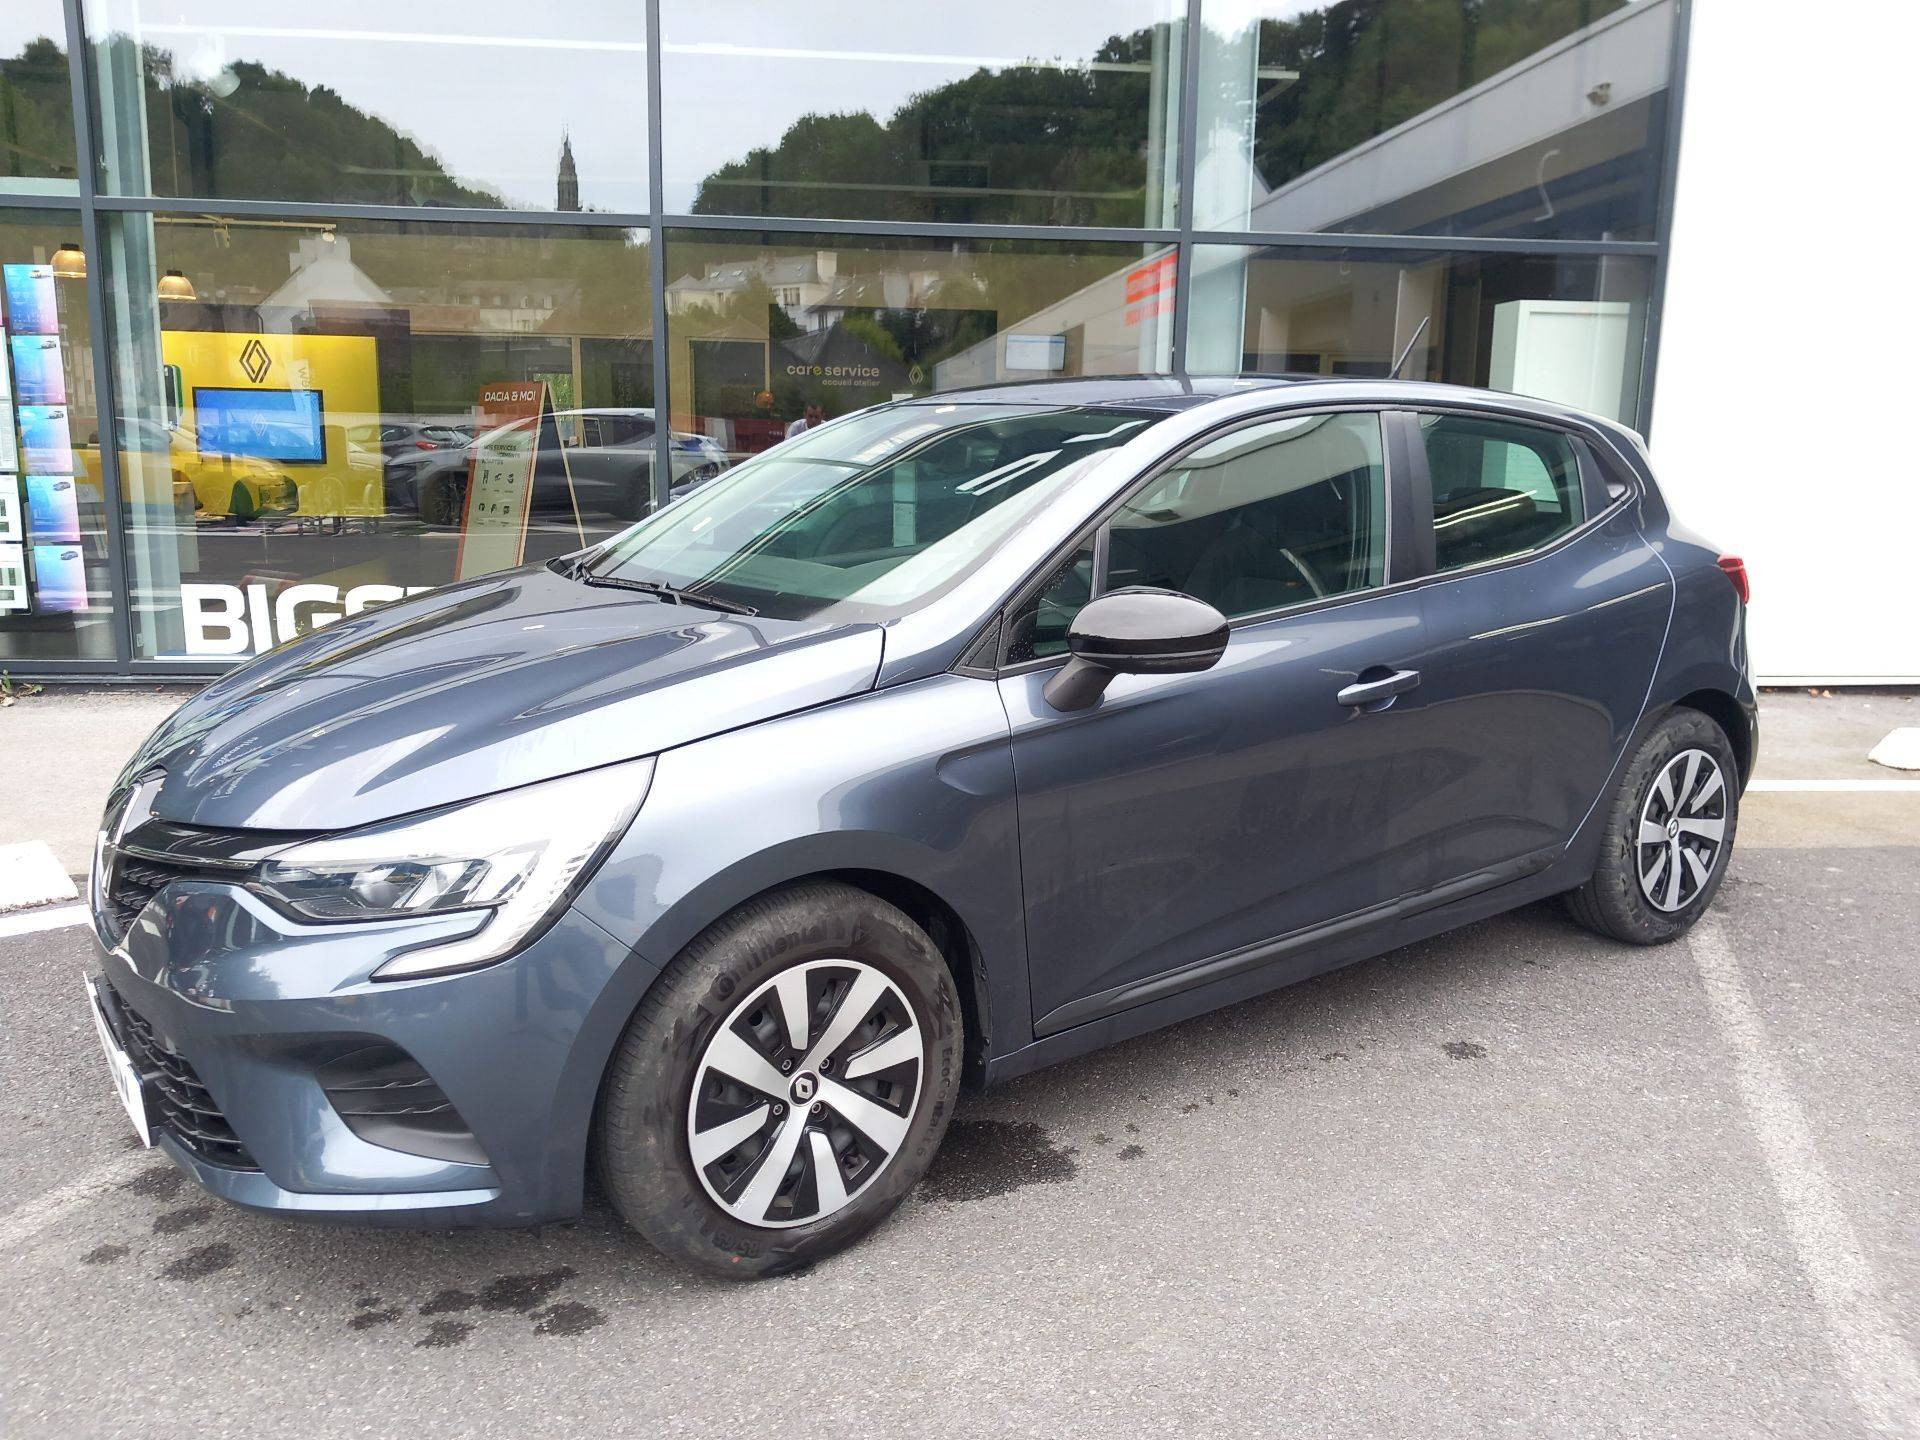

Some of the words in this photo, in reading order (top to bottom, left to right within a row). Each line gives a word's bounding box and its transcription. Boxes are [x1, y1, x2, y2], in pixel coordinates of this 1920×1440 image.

[786, 364, 822, 376] care
[824, 364, 880, 377] service
[853, 379, 880, 387] atelier
[484, 391, 510, 402] DACIA
[511, 391, 518, 402] &
[519, 390, 536, 401] MOI
